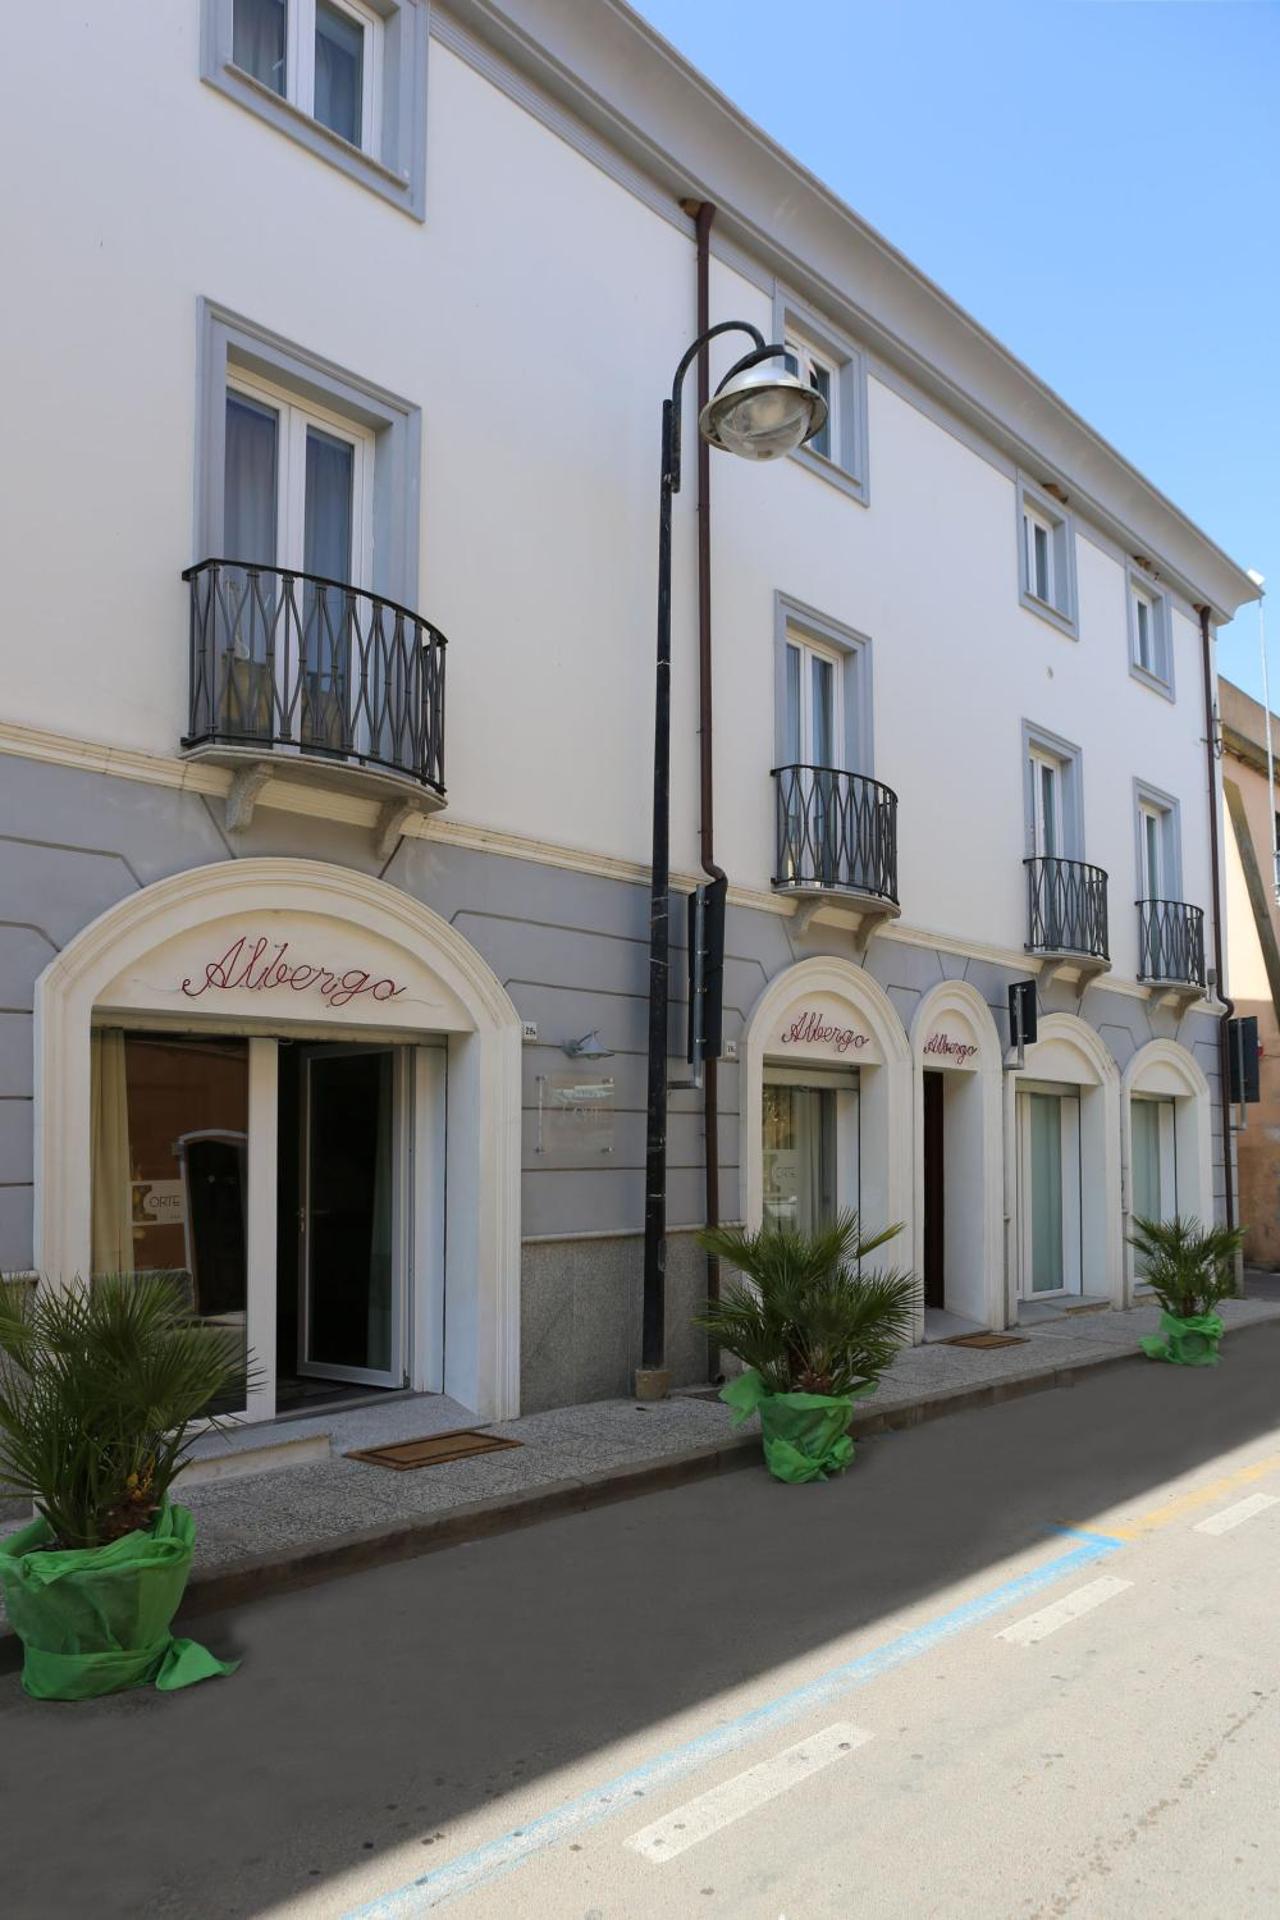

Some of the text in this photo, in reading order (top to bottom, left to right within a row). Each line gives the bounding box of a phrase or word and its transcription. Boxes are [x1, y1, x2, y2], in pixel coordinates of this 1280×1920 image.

[182, 936, 406, 1006] Albergo
[781, 1011, 870, 1053] Albergo
[923, 1033, 978, 1064] Albergo
